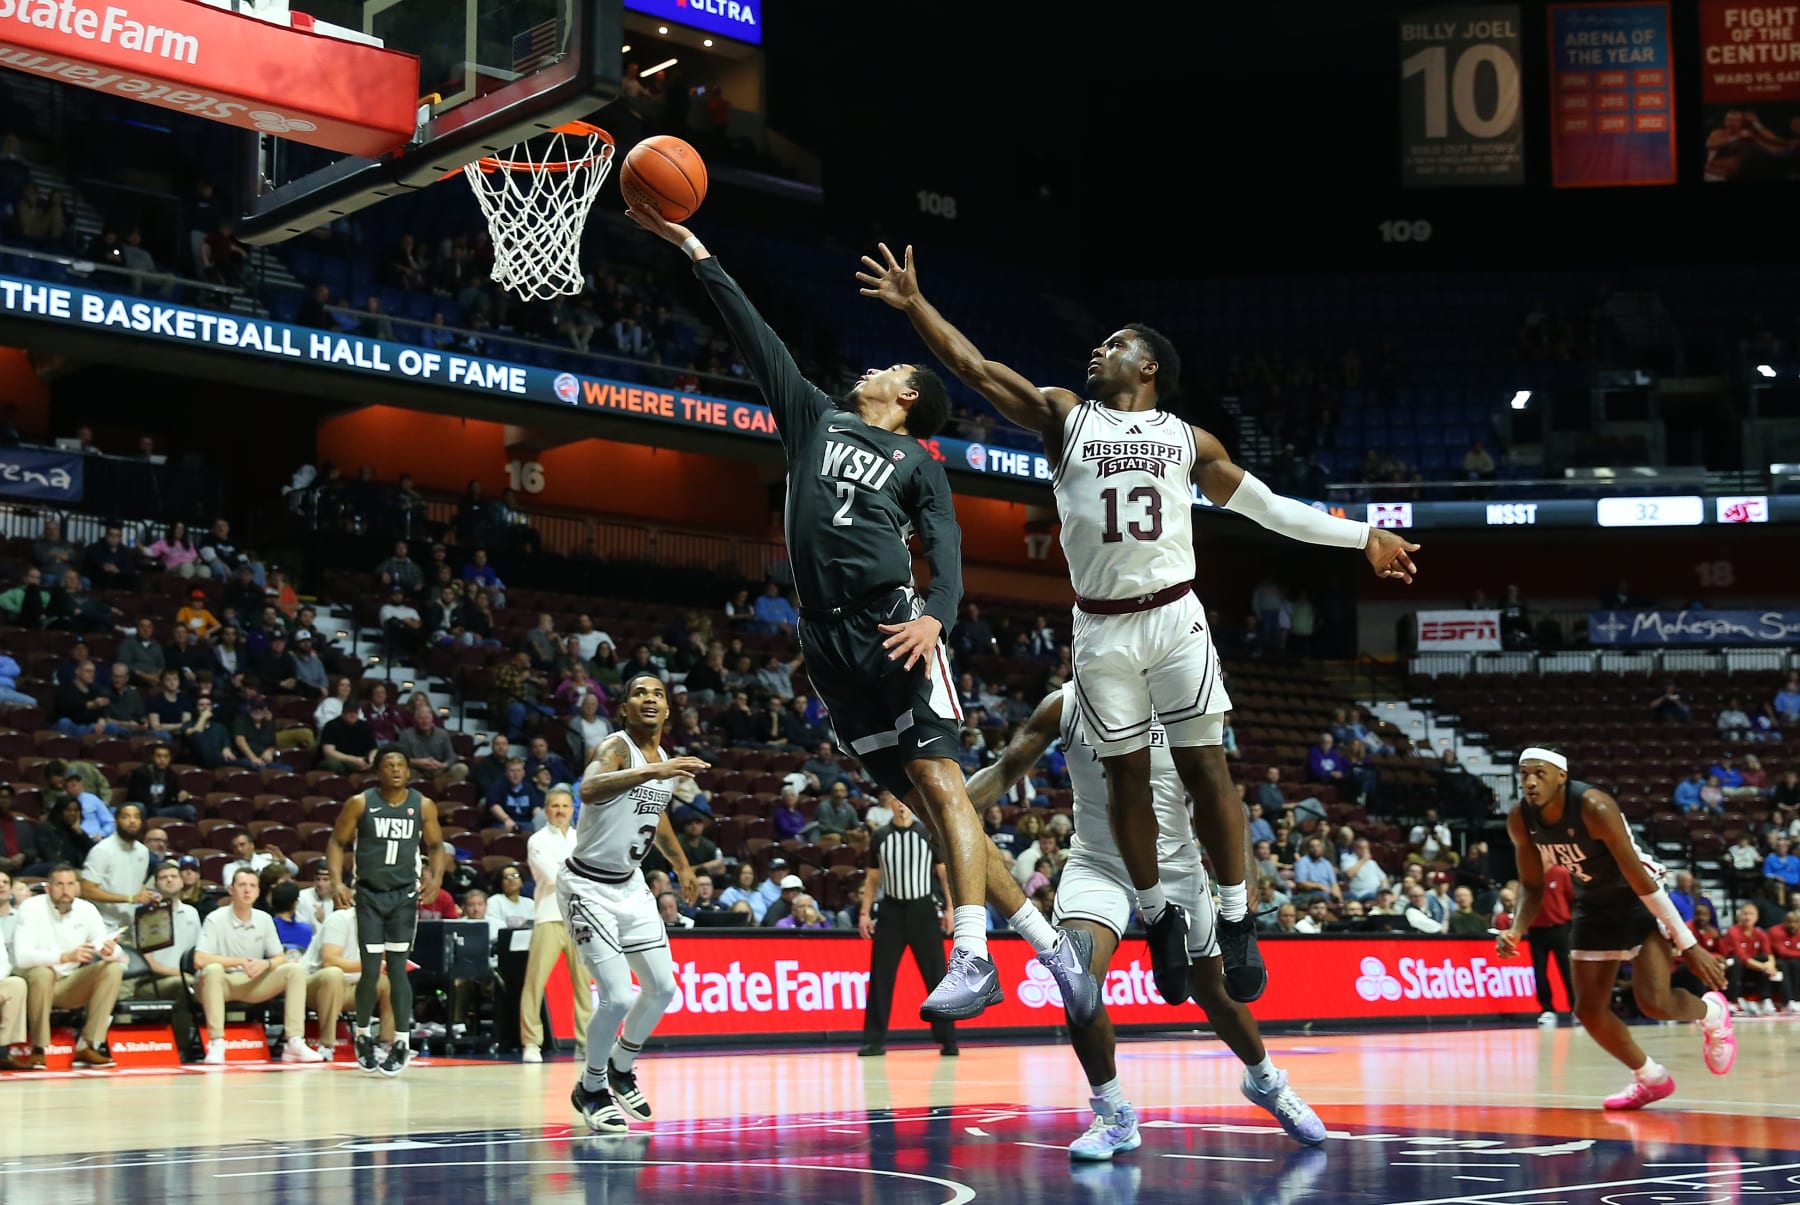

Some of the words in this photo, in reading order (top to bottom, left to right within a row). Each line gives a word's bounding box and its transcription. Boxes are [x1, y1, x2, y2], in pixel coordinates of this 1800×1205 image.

[1724, 7, 1798, 28] FIGHT
[1401, 23, 1456, 41] BILLY
[1462, 21, 1517, 39] JOEL
[1565, 31, 1627, 46] ARENA
[1632, 29, 1655, 45] OF
[1731, 28, 1754, 42] OF
[1758, 27, 1792, 41] THE
[1567, 49, 1602, 65] THE
[1606, 47, 1655, 63] YEAR
[1706, 43, 1800, 64] CENTUR
[1776, 70, 1800, 82] GAT
[1401, 43, 1521, 139] 10
[917, 189, 957, 219] 108
[1378, 219, 1432, 242] 109
[0, 280, 71, 318] THE
[82, 294, 301, 357] BASKETBALL
[309, 333, 391, 371] HALL
[398, 349, 440, 378] OF
[448, 358, 527, 394] FAME
[582, 381, 675, 417] WHERE
[680, 397, 727, 426] THE
[988, 449, 1030, 476] THE
[1082, 443, 1182, 462] MISSISSIPPI
[505, 460, 546, 494] 16
[821, 440, 895, 491] WSU
[1108, 458, 1155, 473] STATE
[832, 481, 856, 527] 2
[1100, 487, 1163, 543] 13
[1486, 504, 1538, 524] MSST
[1636, 504, 1659, 520] 32
[1024, 534, 1052, 560] 17
[1695, 561, 1734, 587] 18
[1422, 620, 1497, 641] ESPN
[1631, 611, 1754, 642] Mohegan
[373, 817, 415, 840] WSU
[384, 839, 399, 865] 11
[630, 824, 657, 861] 3
